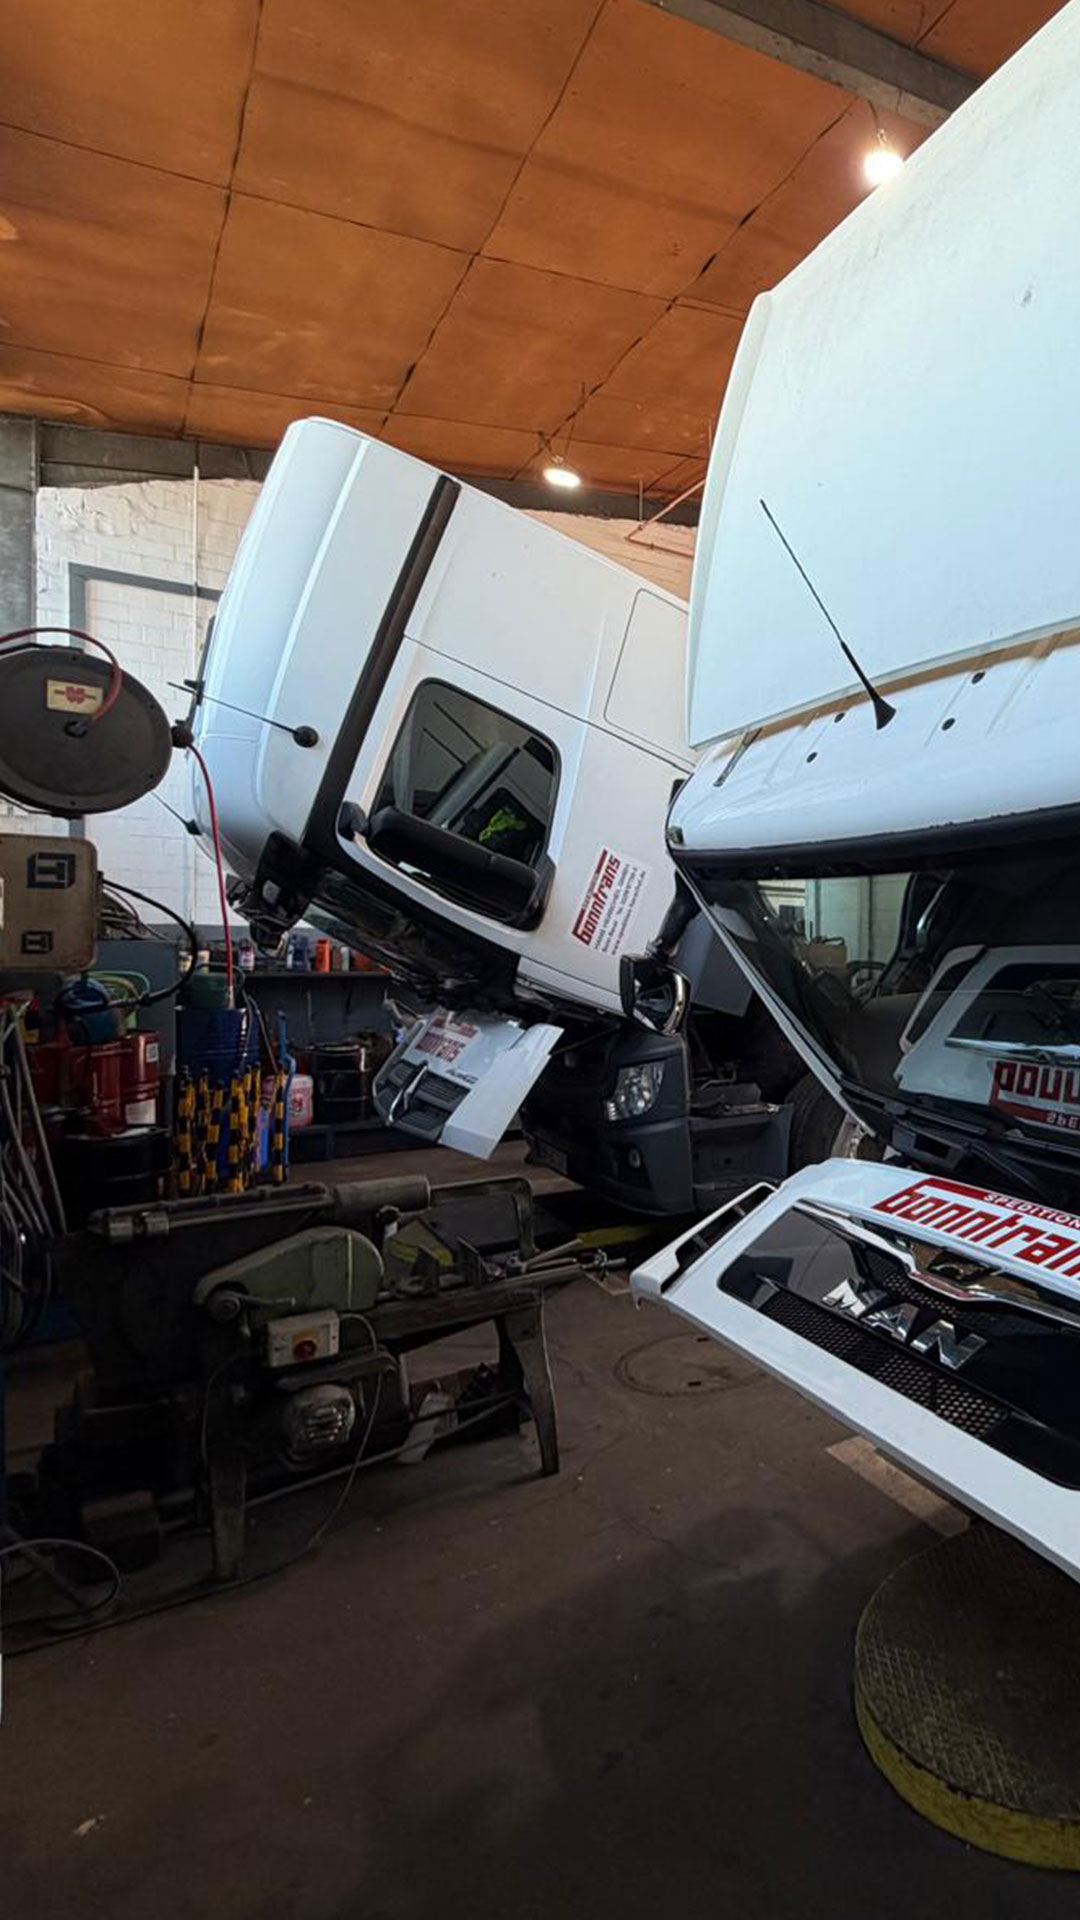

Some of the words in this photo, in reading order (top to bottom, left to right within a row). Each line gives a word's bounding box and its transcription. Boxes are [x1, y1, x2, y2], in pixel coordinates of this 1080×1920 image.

[571, 854, 621, 946] bonntrans
[869, 1177, 1080, 1281] bonntran
[821, 1279, 988, 1370] MAN
